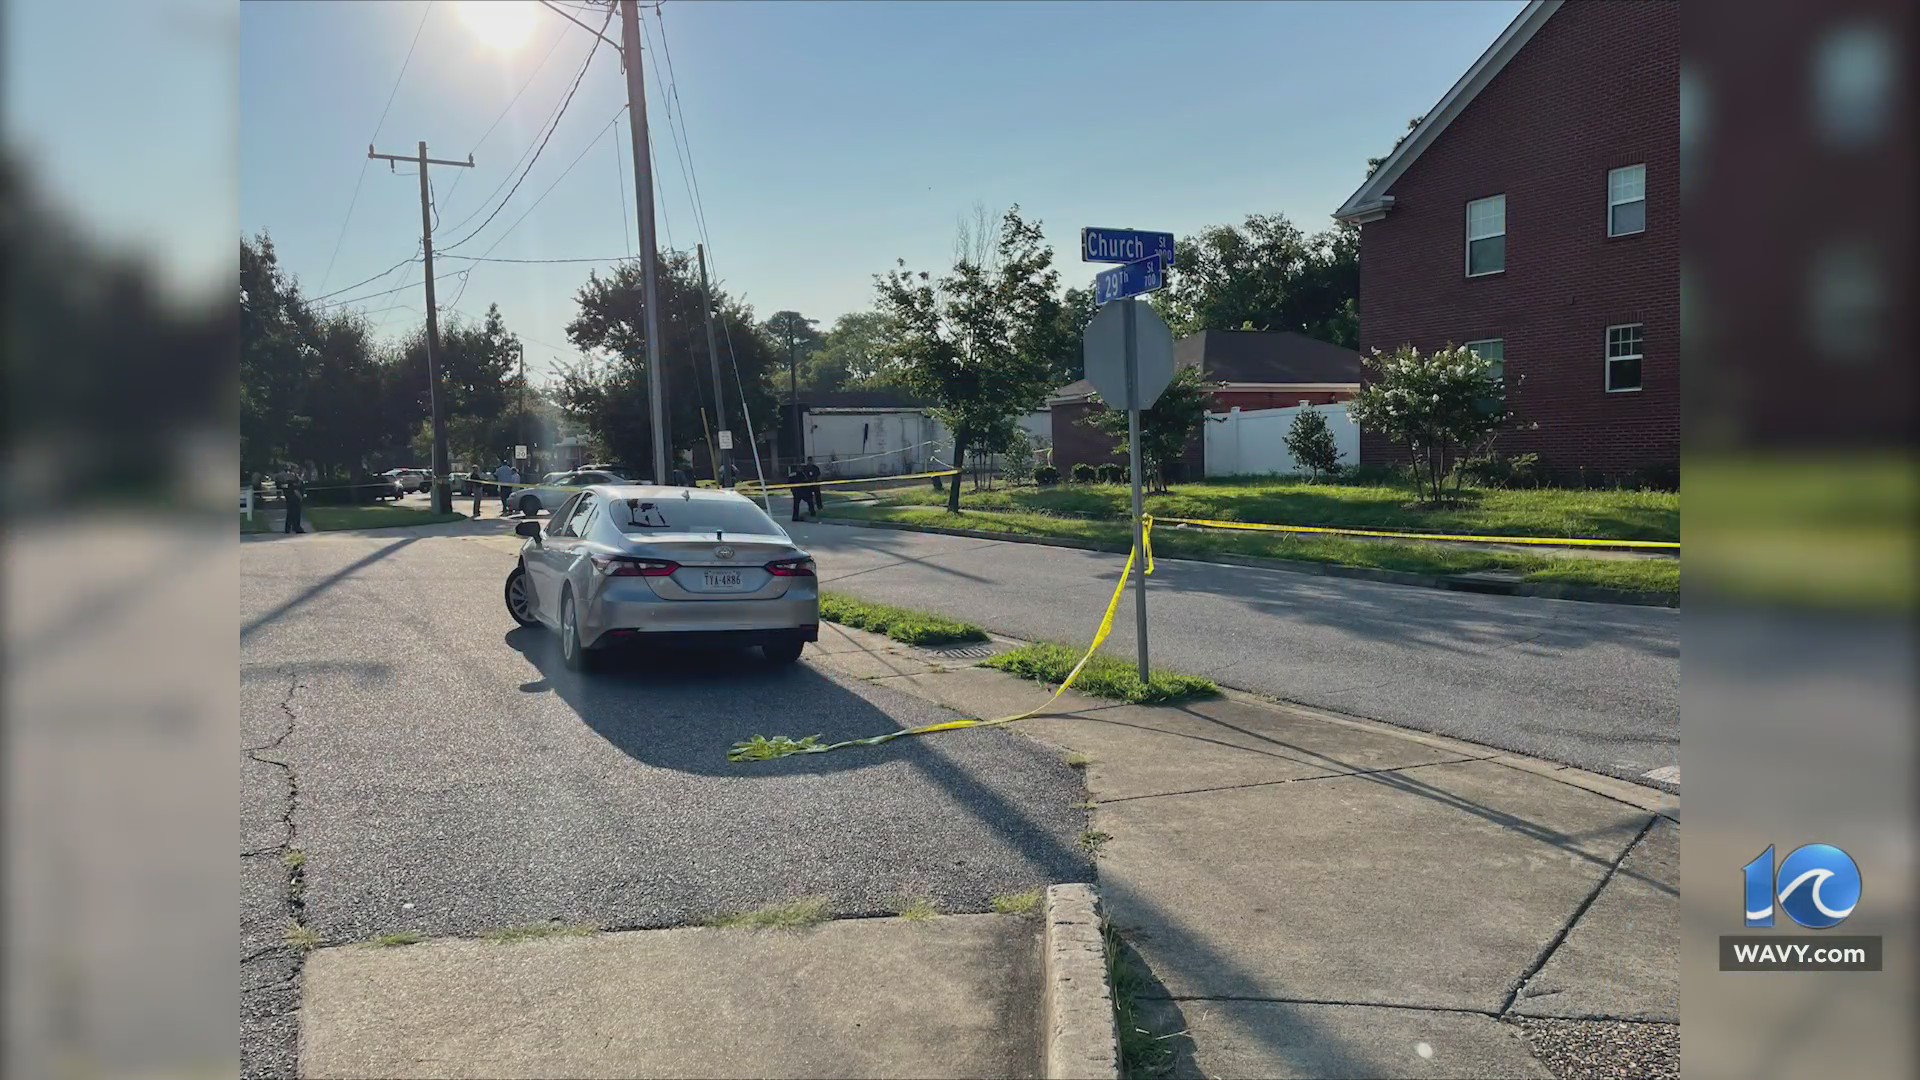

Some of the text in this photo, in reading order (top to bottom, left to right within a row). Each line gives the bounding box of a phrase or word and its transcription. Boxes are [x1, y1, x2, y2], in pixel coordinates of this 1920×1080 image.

[1088, 231, 1166, 258] Church St
[1146, 262, 1154, 273] St
[1144, 273, 1156, 287] 700
